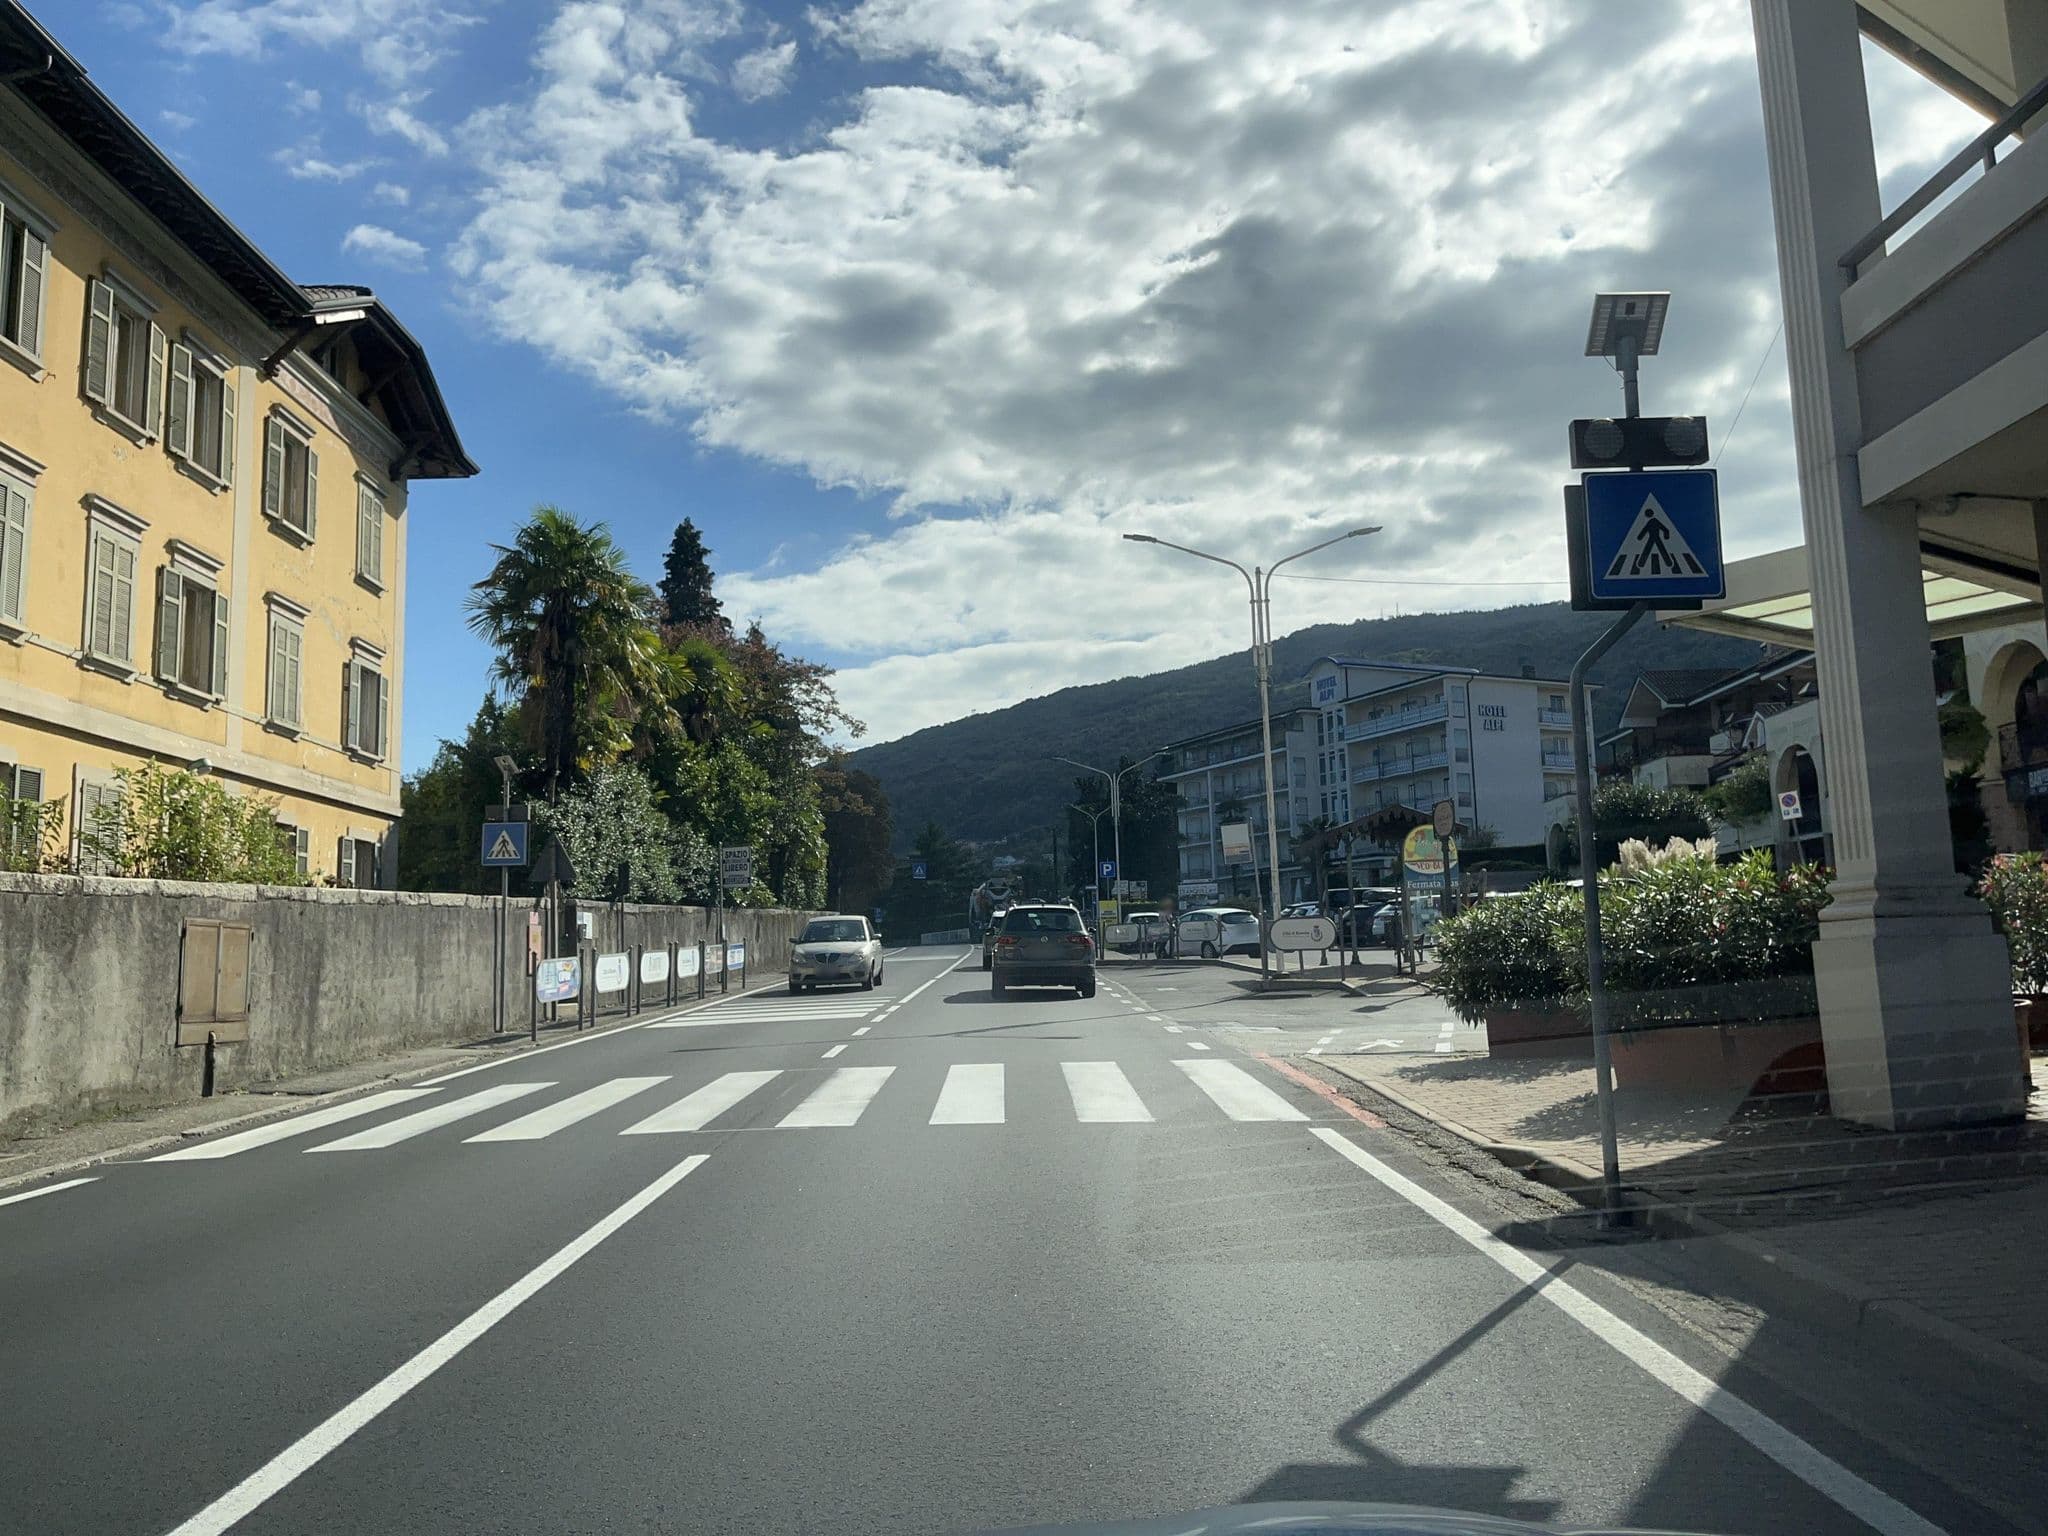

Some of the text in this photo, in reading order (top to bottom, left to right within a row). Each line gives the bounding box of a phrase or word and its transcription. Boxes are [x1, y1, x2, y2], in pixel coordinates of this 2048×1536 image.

[1316, 675, 1337, 690] HOTEL
[1319, 687, 1335, 702] ALPI
[1478, 704, 1507, 717] HOTEL
[1483, 719, 1505, 731] ALPI
[725, 850, 748, 859] SPAZIO
[724, 863, 748, 872] LIBERO
[1103, 863, 1112, 875] P
[1407, 881, 1441, 889] Fermata
